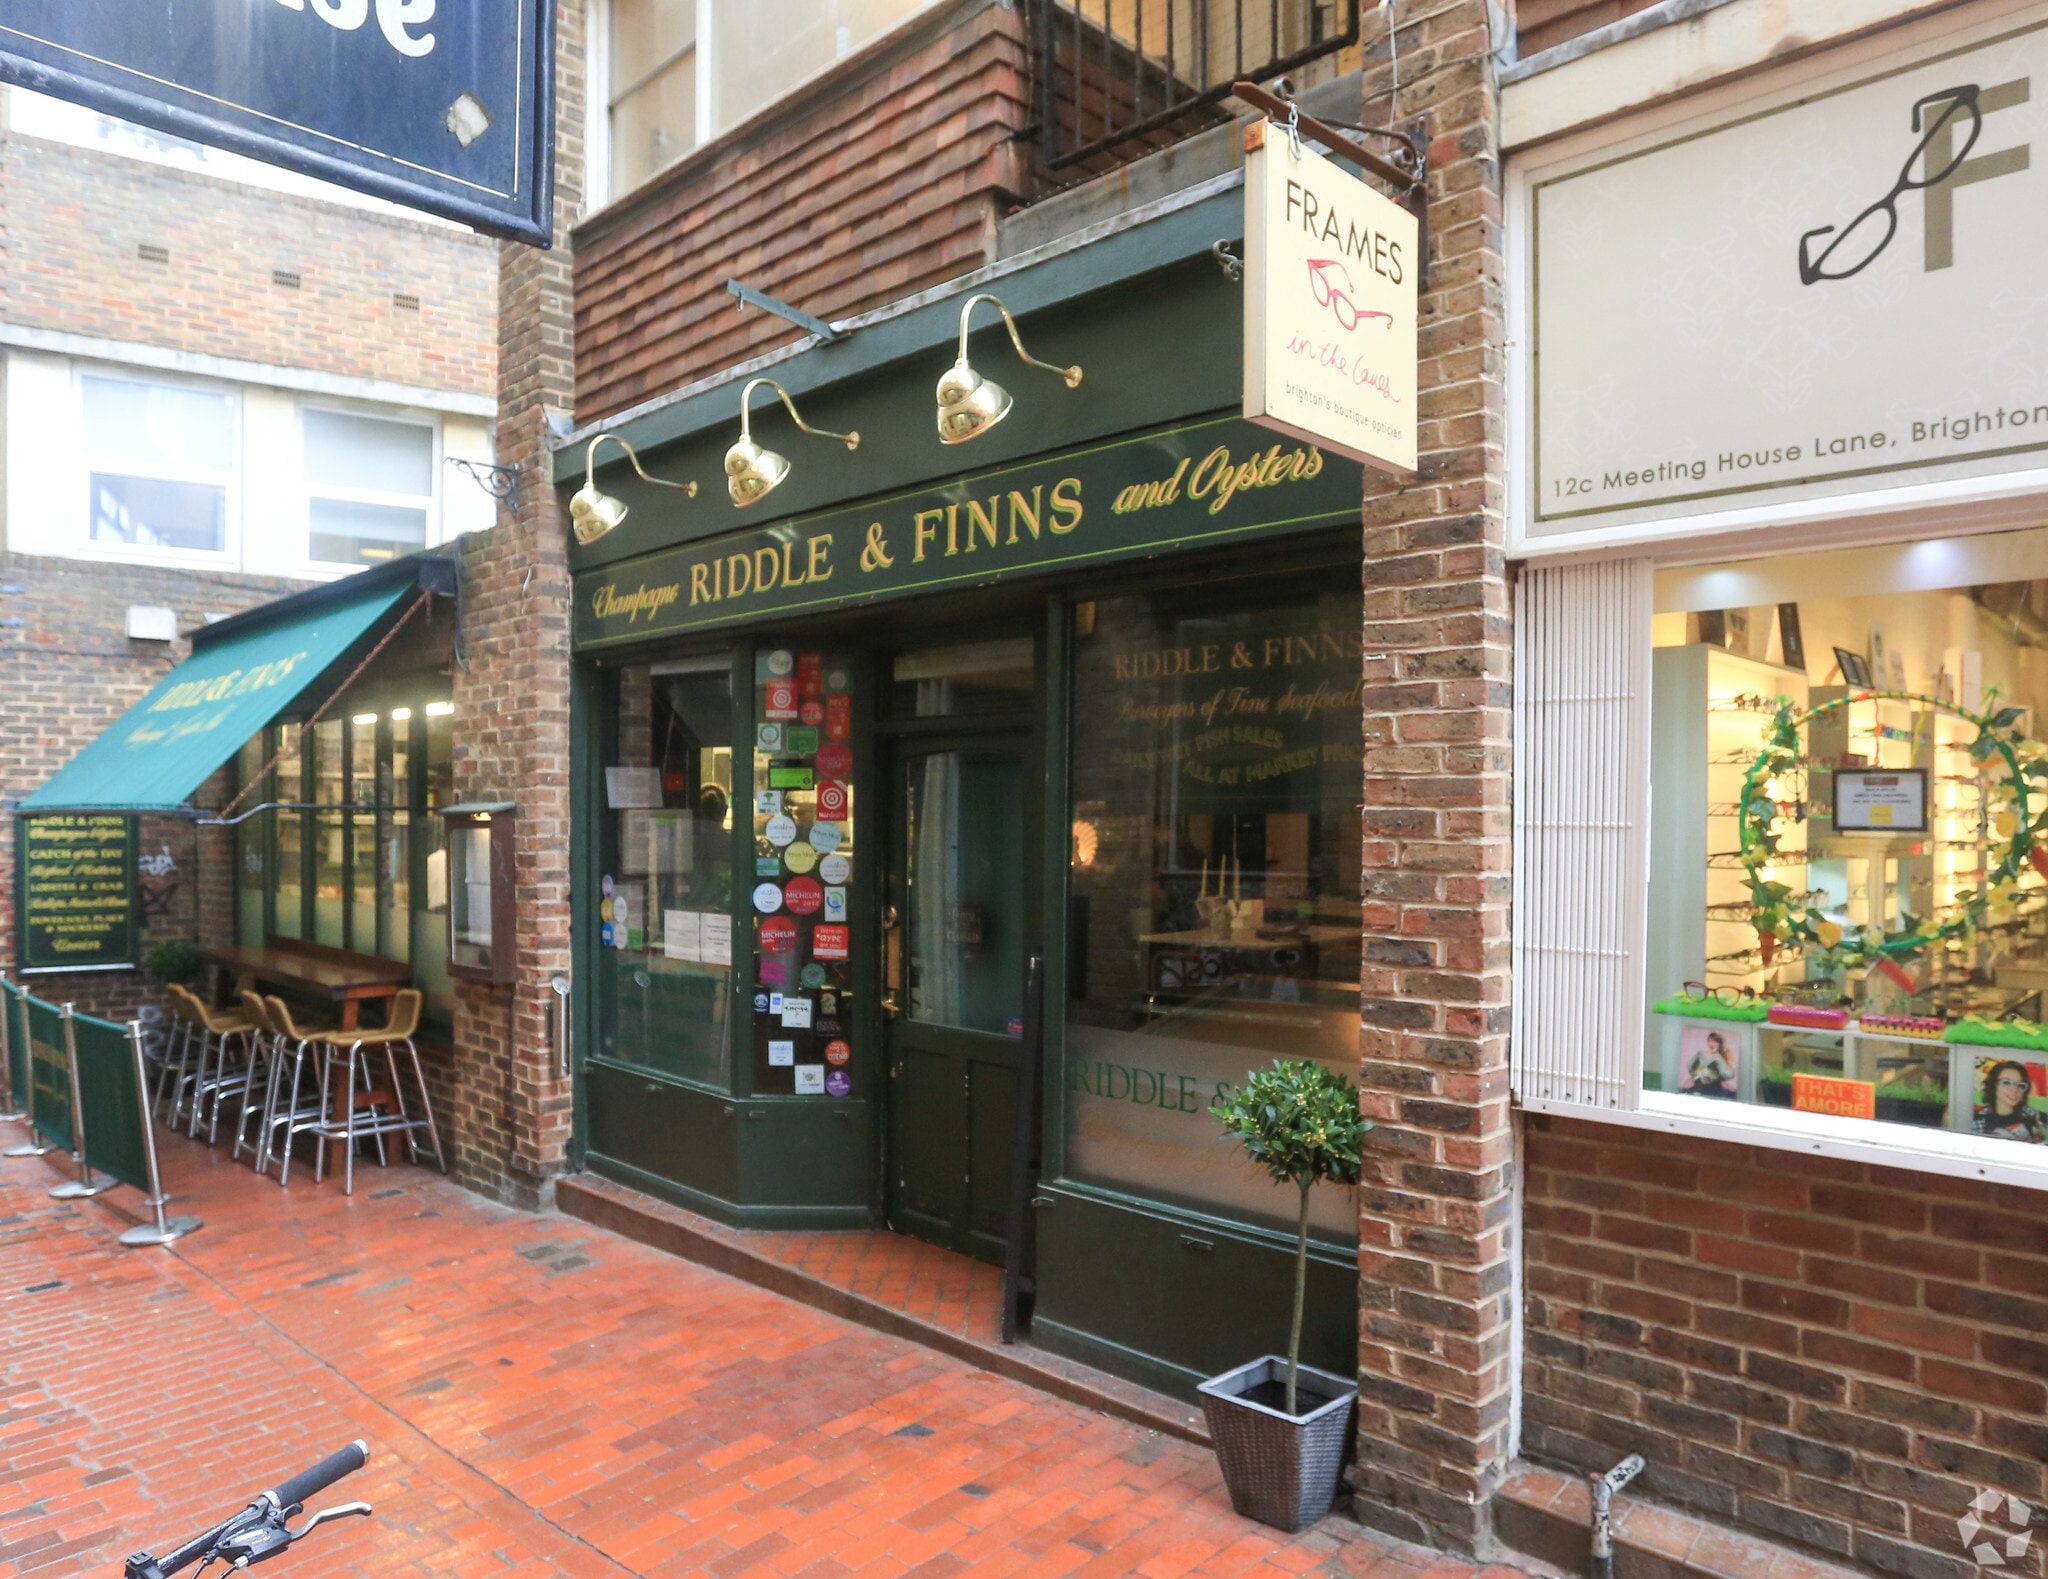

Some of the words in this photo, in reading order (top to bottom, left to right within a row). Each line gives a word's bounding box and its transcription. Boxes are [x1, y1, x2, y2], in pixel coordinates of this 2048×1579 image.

[1286, 178, 1403, 285] FRAMES
[1286, 335, 1316, 359] in
[1320, 343, 1348, 376] the
[1285, 380, 1331, 411] brighton's
[1333, 400, 1369, 426] boutique
[1371, 419, 1402, 440] optician
[1553, 477, 1593, 497] 12c
[1602, 460, 1707, 490] Meeting
[1718, 445, 1802, 473] House
[1814, 432, 1897, 457] Lane,
[1912, 405, 2048, 442] Brighton
[592, 583, 680, 623] Champagne
[689, 533, 834, 606] RIDDLE
[860, 522, 895, 572] &
[912, 477, 1083, 563] FINNS
[1111, 457, 1191, 515] and
[1187, 445, 1323, 515] Oysters
[1114, 644, 1221, 679] RIDDLE
[1230, 642, 1254, 669] &
[1264, 631, 1362, 666] FINNS
[1200, 687, 1226, 726] of
[1224, 685, 1271, 715] Fine
[761, 930, 795, 938] MICHELIN
[1072, 1057, 1199, 1114] RIDDLE
[1795, 1095, 1867, 1117] AMORE
[1796, 1078, 1865, 1100] THAT'S
